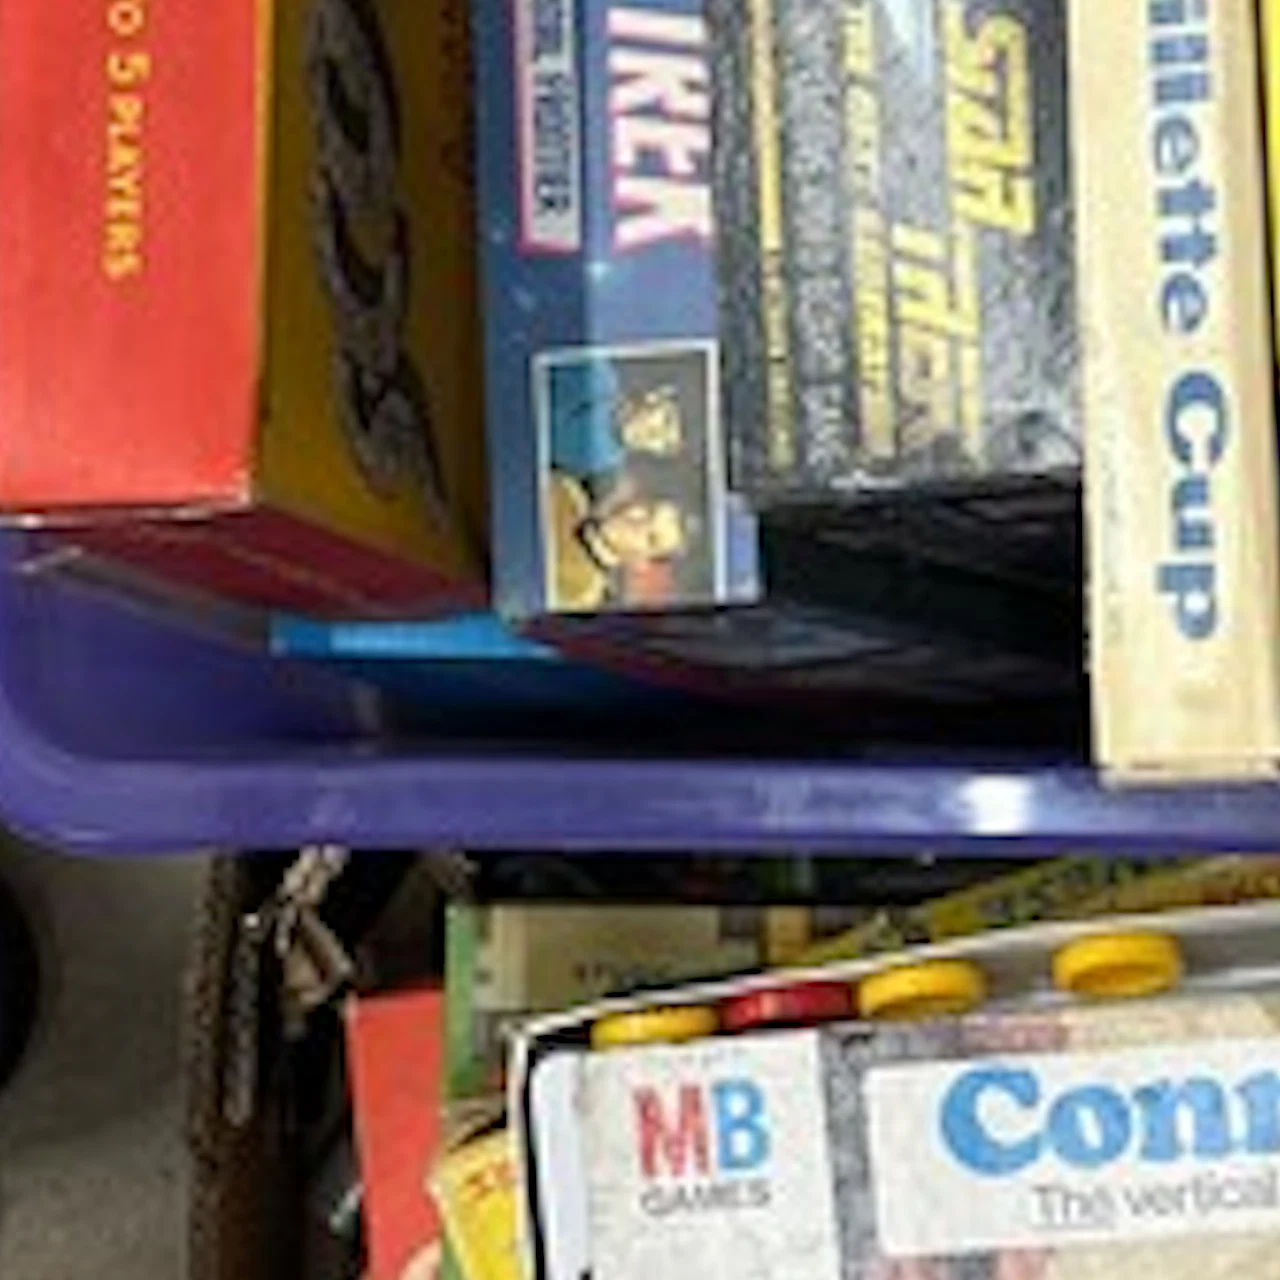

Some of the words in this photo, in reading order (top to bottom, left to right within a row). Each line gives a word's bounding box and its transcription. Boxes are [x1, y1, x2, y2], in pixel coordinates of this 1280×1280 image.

[107, 53, 152, 85] 5
[102, 97, 144, 282] PLAYERS
[1154, 370, 1231, 644] Cup
[633, 1075, 770, 1177] MB
[639, 1178, 771, 1217] GAMES
[1032, 1184, 1116, 1230] The
[1121, 1167, 1279, 1221] vertical
